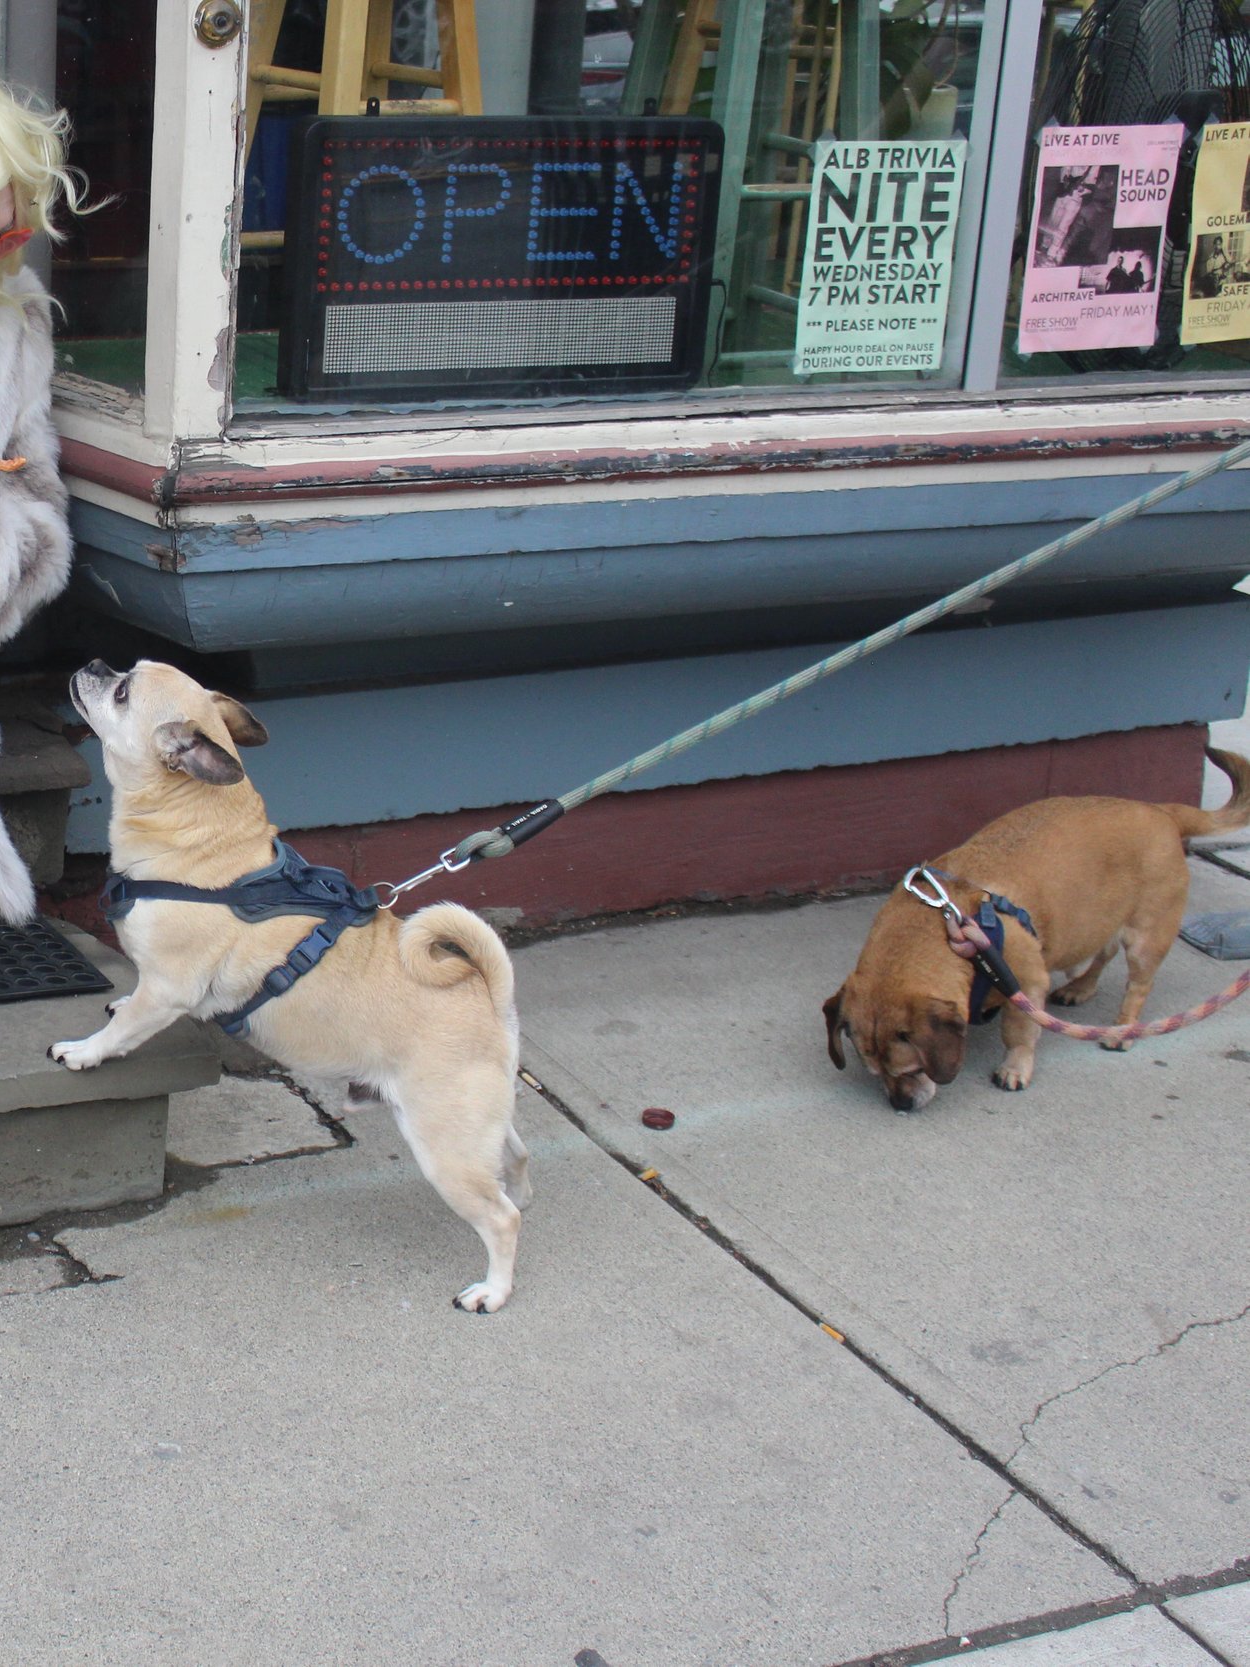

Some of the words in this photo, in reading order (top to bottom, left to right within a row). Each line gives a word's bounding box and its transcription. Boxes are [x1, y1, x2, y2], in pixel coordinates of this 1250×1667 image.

[1044, 134, 1071, 147] LIVE
[1072, 134, 1090, 146] AT
[1092, 133, 1121, 145] DIVE
[1205, 128, 1229, 142] LIVE
[1231, 127, 1246, 140] AT
[823, 148, 870, 170] ALB
[878, 147, 956, 169] TRIVIA
[1121, 169, 1170, 187] HEAD
[817, 172, 956, 224] NITE
[1120, 189, 1167, 203] SOUND
[337, 161, 685, 265] OPEN
[1206, 213, 1246, 228] GOLEM
[813, 225, 947, 263] EVERY
[813, 263, 943, 283] WEDNESDAY
[807, 286, 822, 307] 7
[827, 285, 860, 306] PM
[867, 283, 941, 305] START
[1031, 290, 1095, 303] ARCHITRAVE
[1223, 283, 1250, 297] SAFE
[1080, 306, 1121, 320] FRIDAY
[1123, 304, 1150, 316] MAY
[1206, 299, 1247, 313] FRIDAY
[825, 319, 876, 332] PLEASE
[878, 318, 917, 331] NOTE
[1025, 318, 1048, 329] FREE
[1049, 316, 1079, 328] SHOW
[1188, 315, 1205, 325] FREE
[1206, 314, 1231, 324] SHOW
[804, 346, 832, 355] HAPPY
[834, 345, 863, 354] HOUR
[864, 344, 887, 353] DEAL
[889, 344, 904, 352] ON
[905, 343, 935, 352] PAUSE
[802, 357, 854, 369] DURING
[857, 355, 885, 367] OUR
[886, 354, 933, 366] EVENTS
